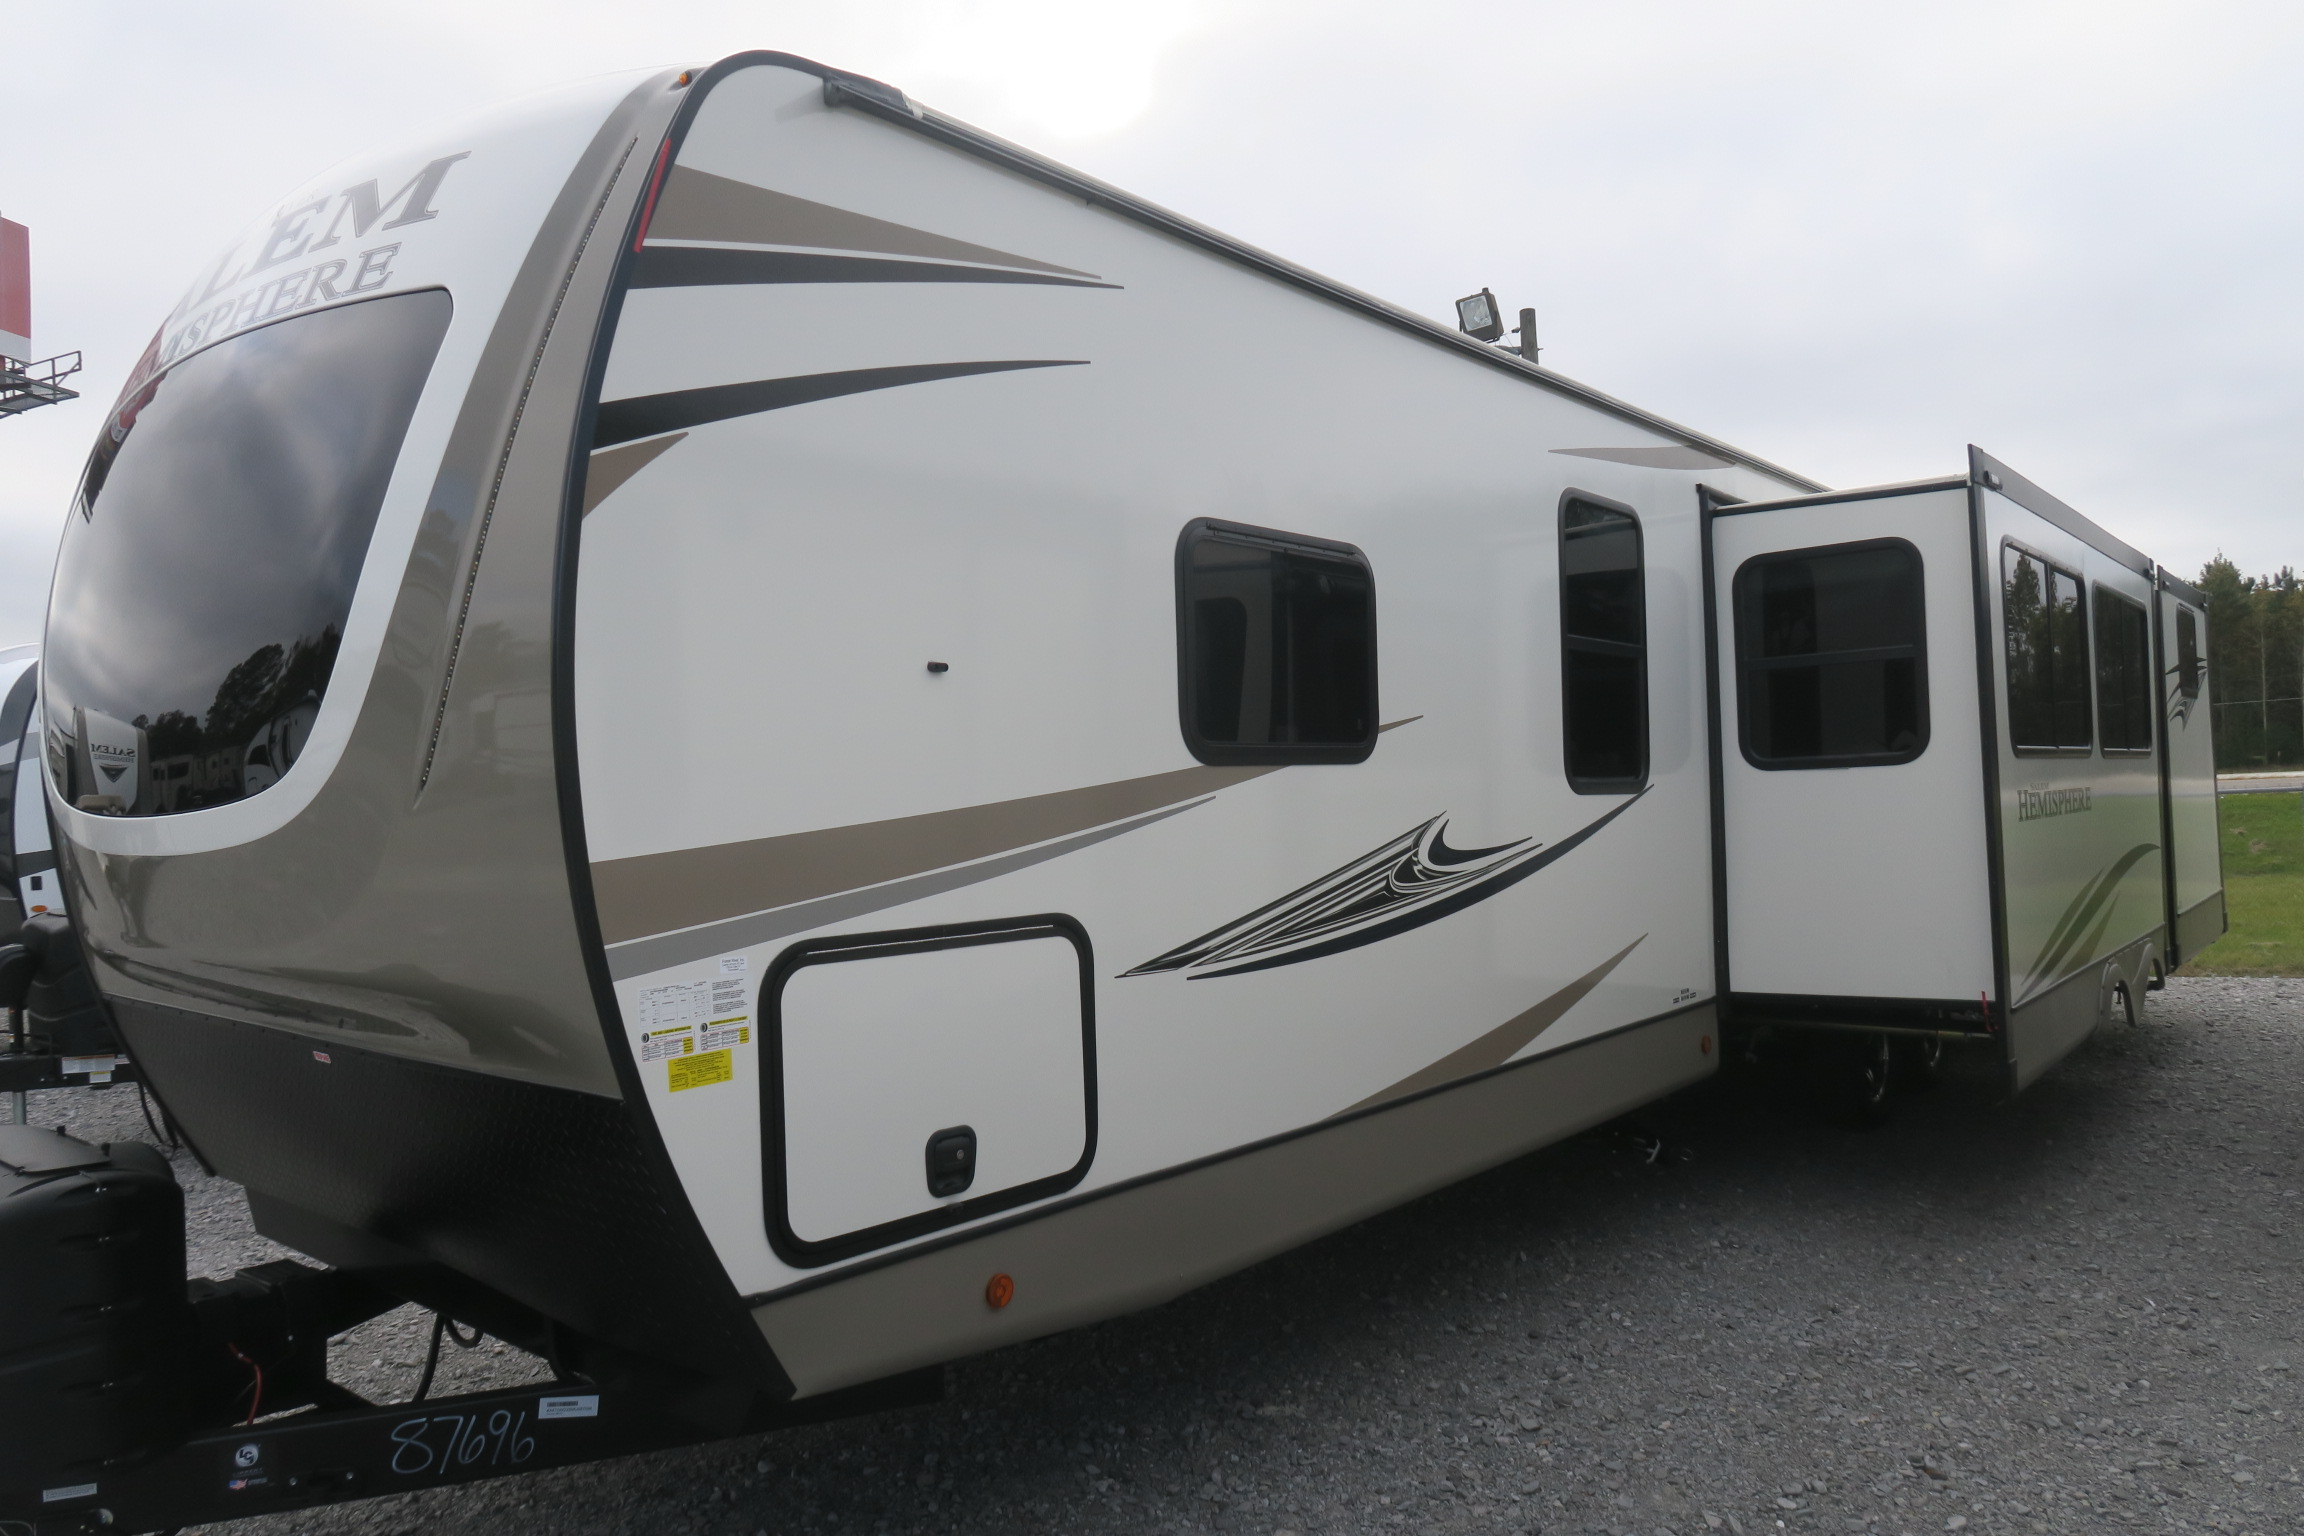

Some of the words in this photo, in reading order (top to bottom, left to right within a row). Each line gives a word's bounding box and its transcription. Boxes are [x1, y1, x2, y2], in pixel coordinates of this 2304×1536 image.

[166, 150, 472, 323] LEM
[152, 241, 402, 366] ISPHERE
[2017, 787, 2092, 822] HEMISPHERE
[391, 1410, 534, 1475] 87696
